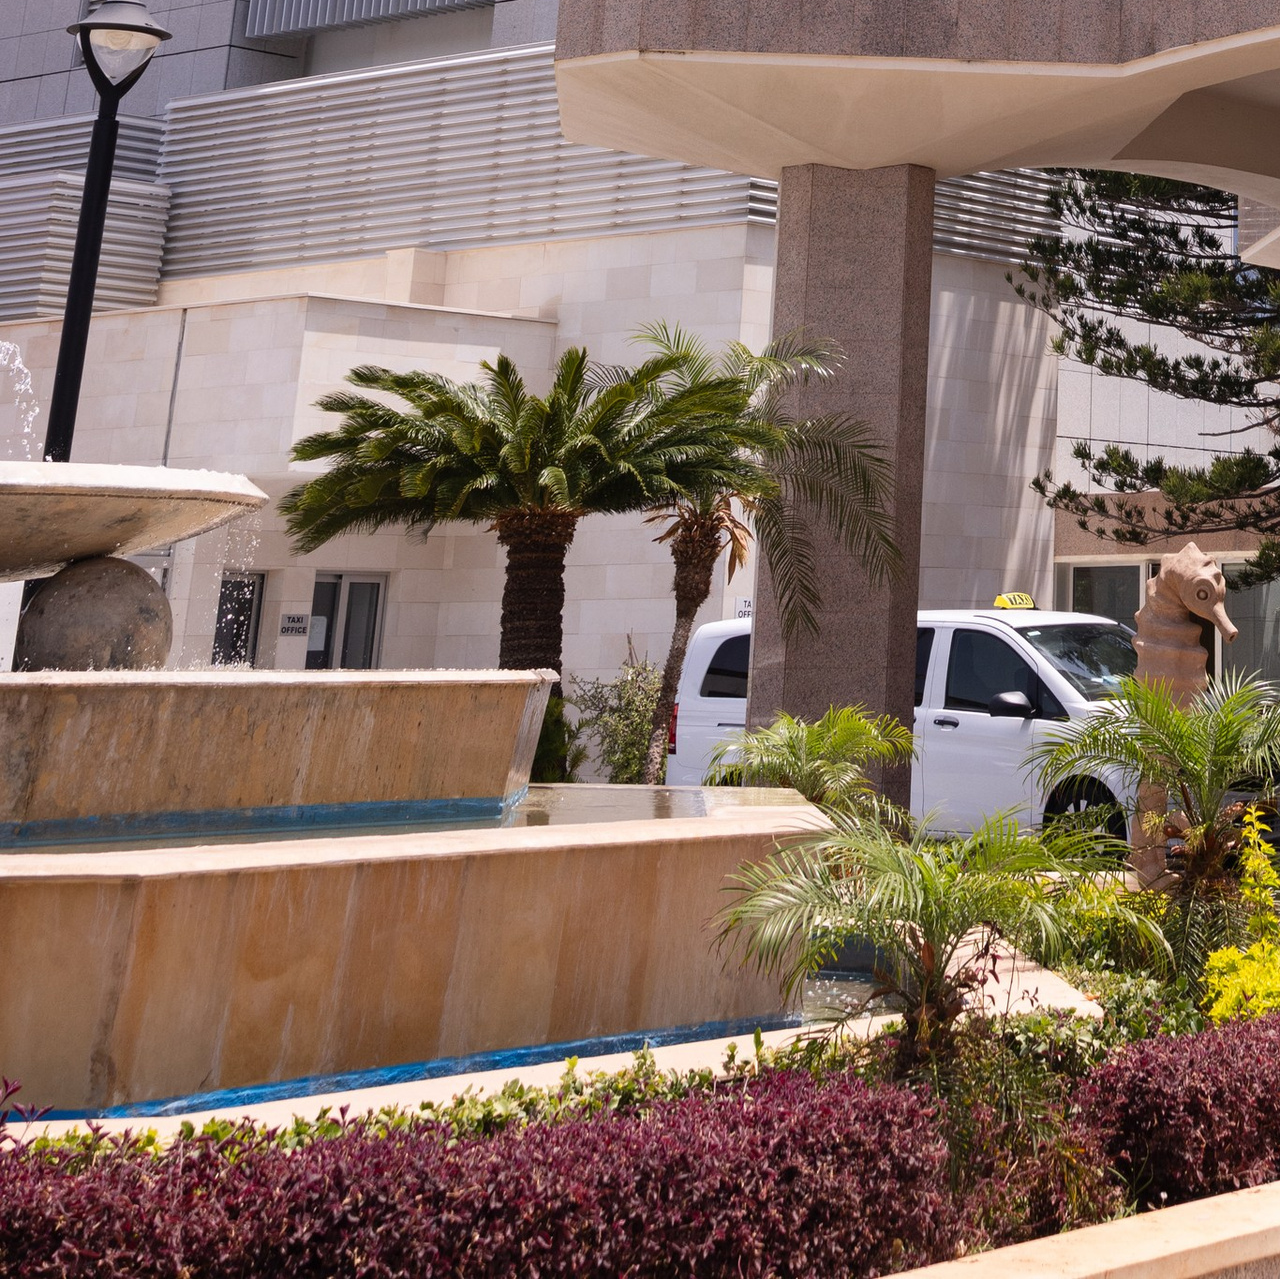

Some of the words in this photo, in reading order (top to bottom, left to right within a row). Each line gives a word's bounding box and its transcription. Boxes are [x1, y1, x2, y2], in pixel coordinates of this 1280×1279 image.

[1006, 594, 1032, 605] TAXI
[286, 616, 304, 624] TAXI
[281, 626, 307, 634] OFFICE
